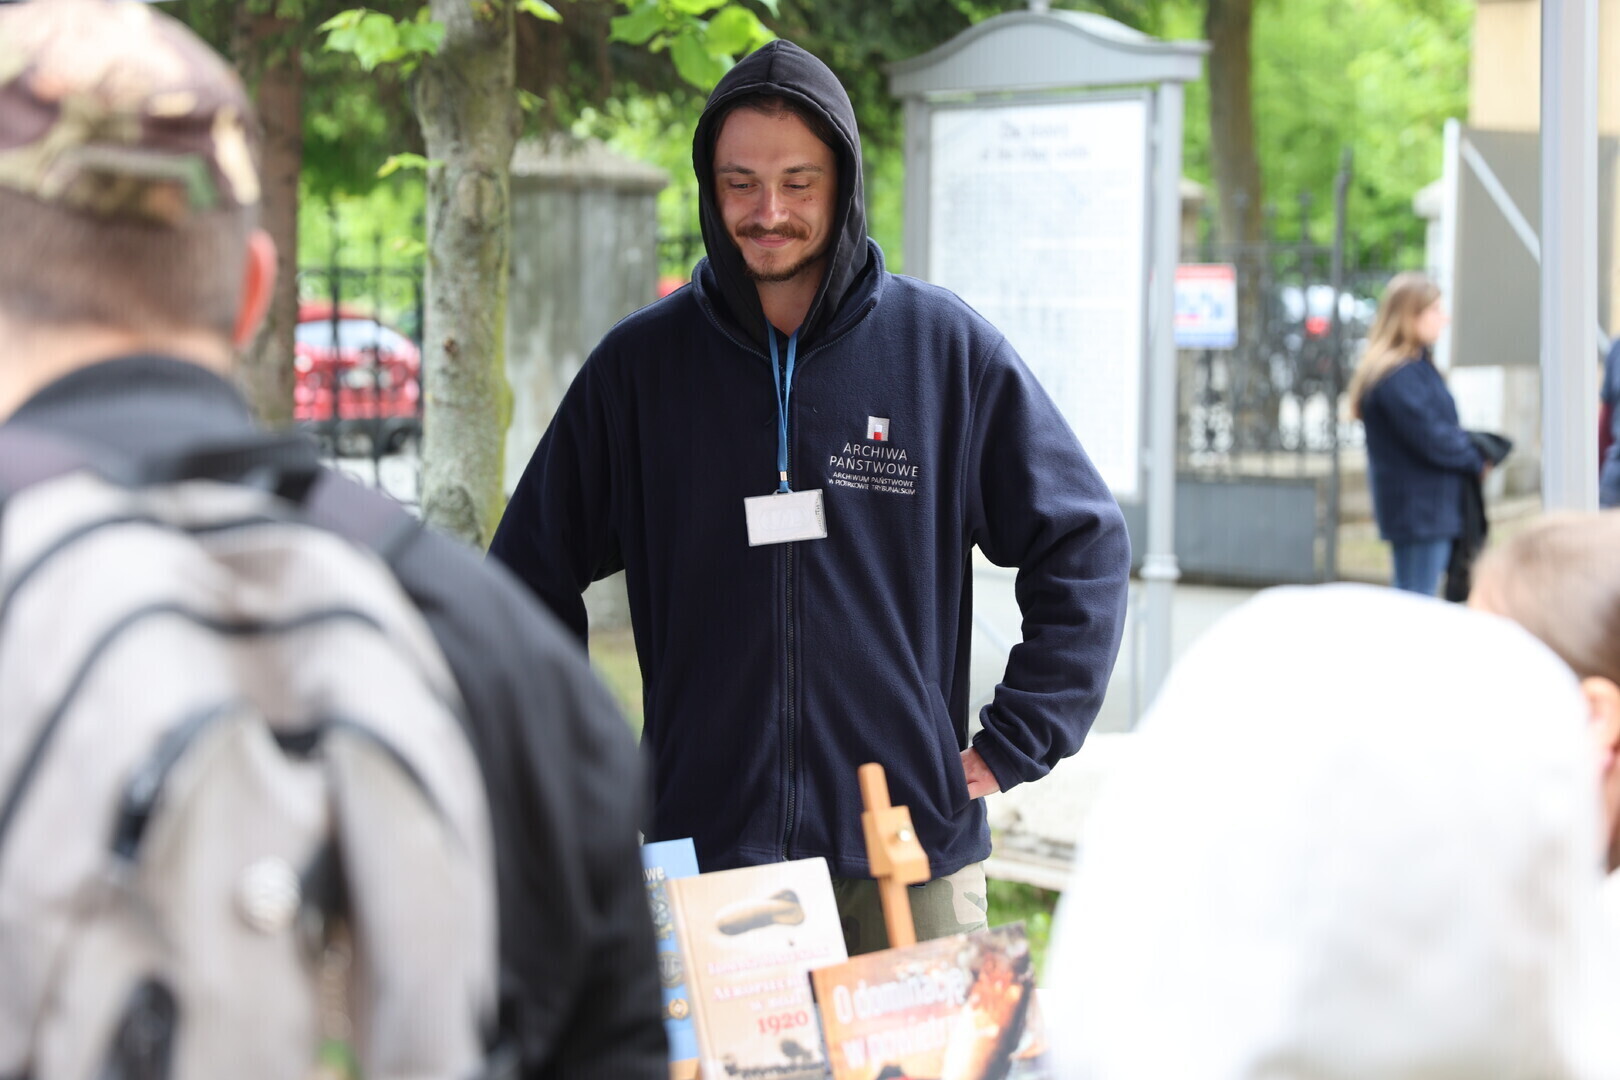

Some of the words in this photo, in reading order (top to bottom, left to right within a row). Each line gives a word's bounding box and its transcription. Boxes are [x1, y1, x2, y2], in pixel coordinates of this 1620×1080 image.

[843, 442, 908, 461] ARCHIWA
[829, 455, 919, 477] PAŃSTWOWE
[833, 471, 870, 483] ARCHIWUM
[870, 476, 914, 487] PAŃSTWOWE
[835, 479, 869, 490] PIOTRKOWIE
[871, 484, 916, 496] TRYBUNALSKIM
[757, 1010, 809, 1035] 1920
